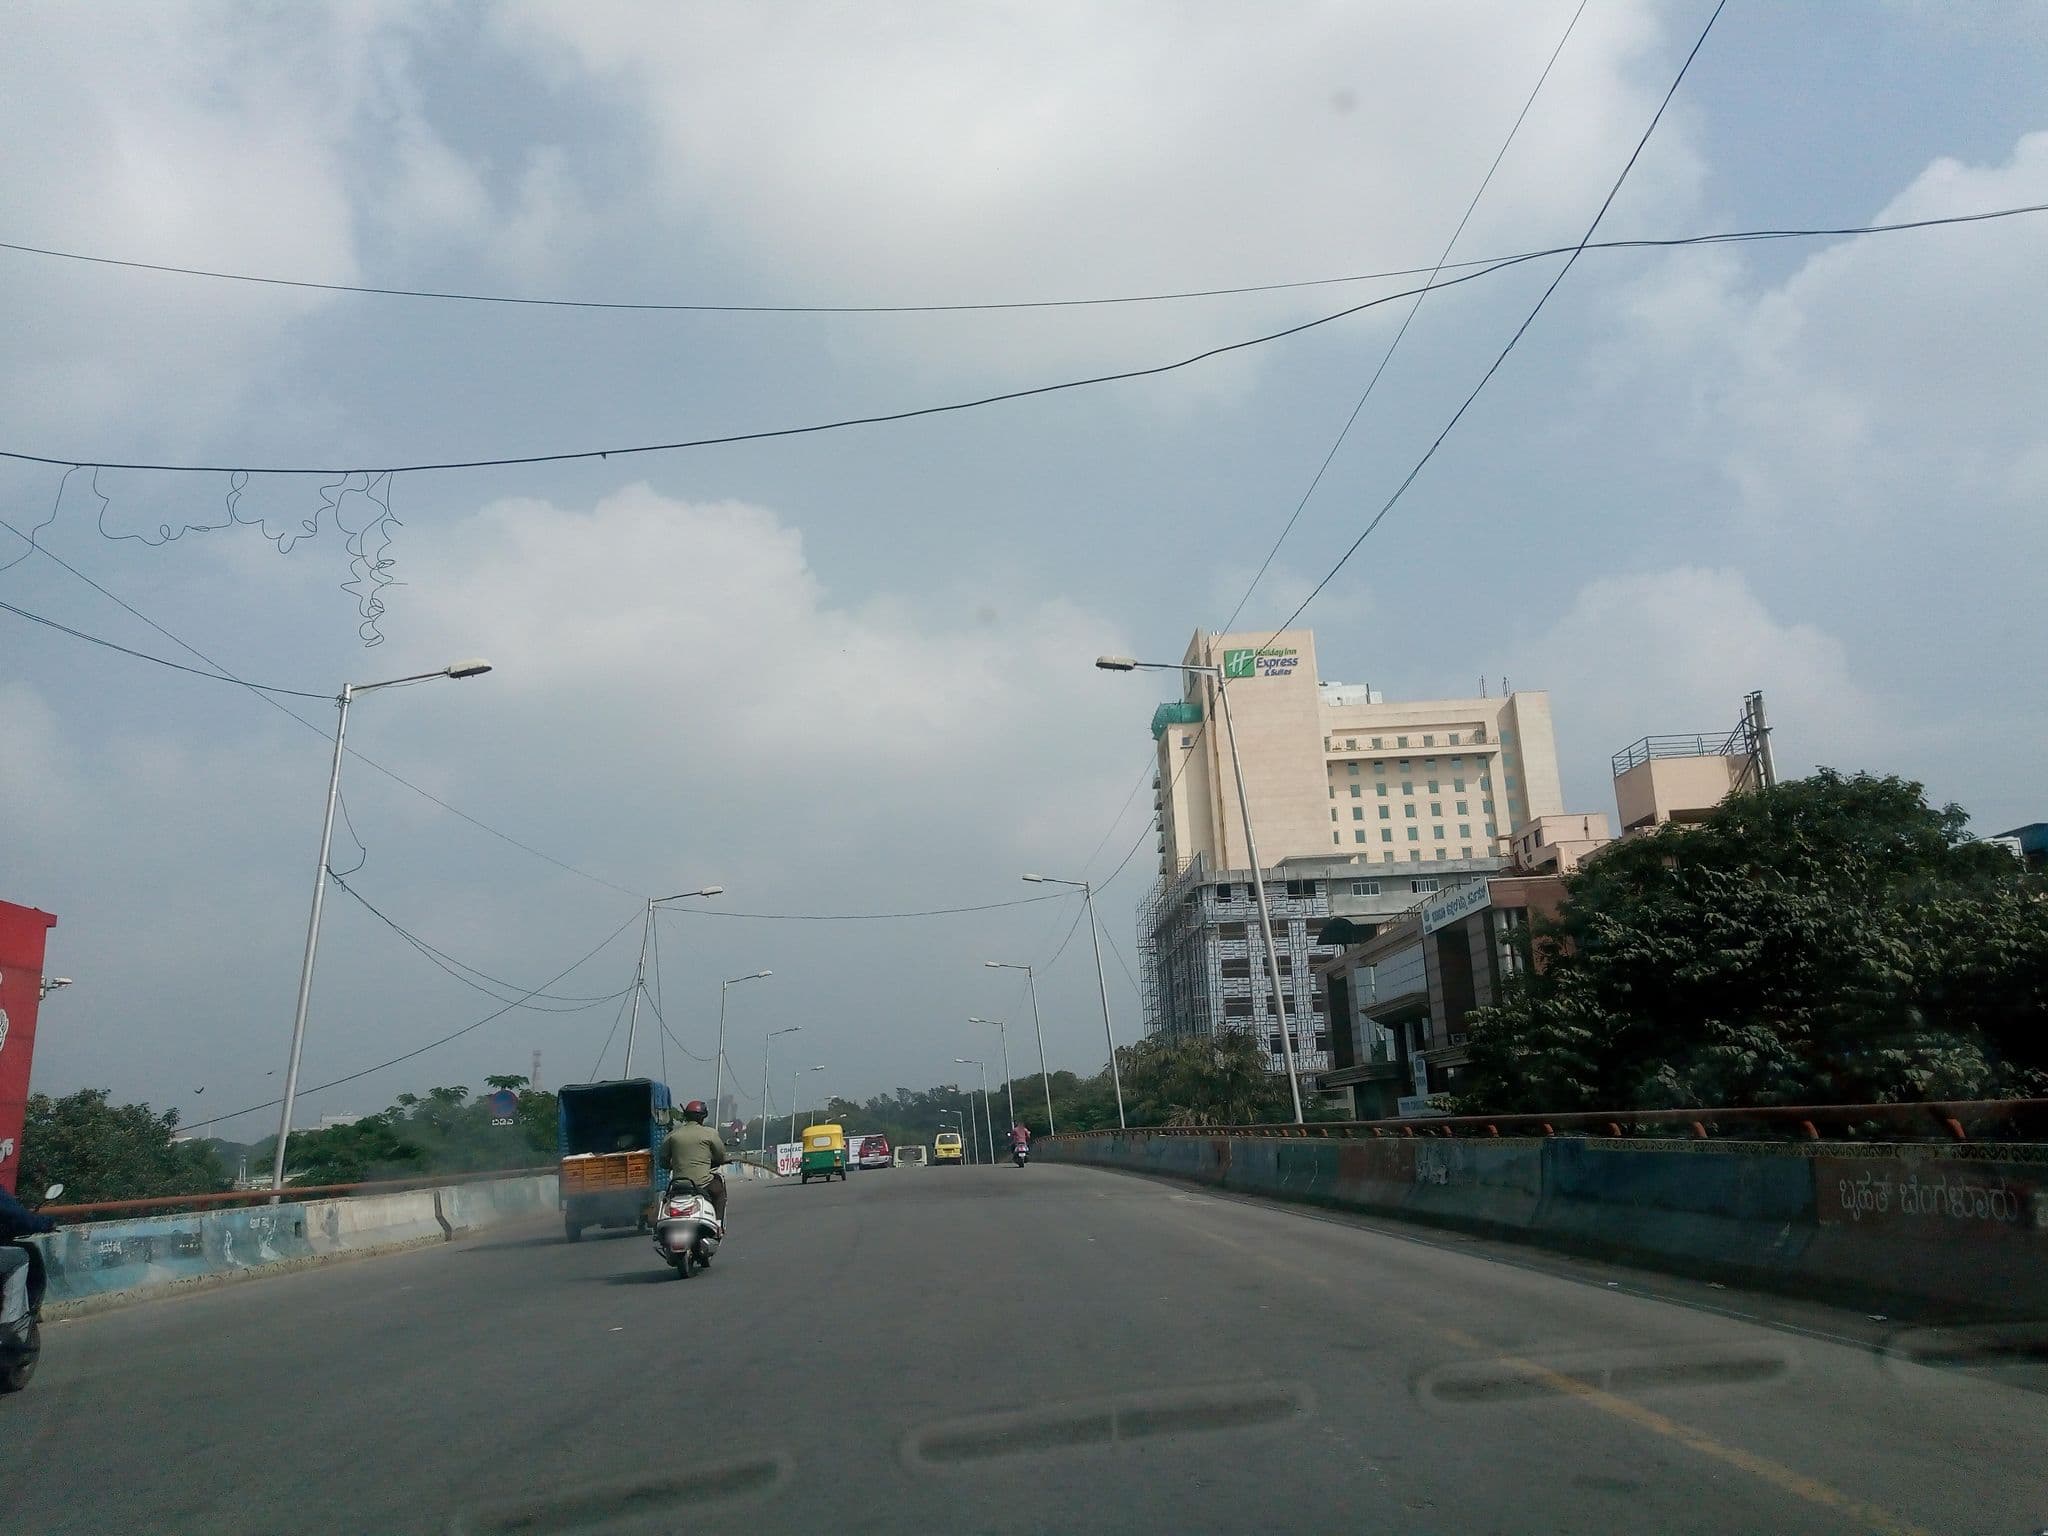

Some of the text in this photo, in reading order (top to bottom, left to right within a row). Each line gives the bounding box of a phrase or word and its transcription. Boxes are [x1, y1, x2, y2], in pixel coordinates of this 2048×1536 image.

[1256, 648, 1283, 657] Holiday
[1256, 657, 1299, 669] Express
[1271, 668, 1292, 676] Suites
